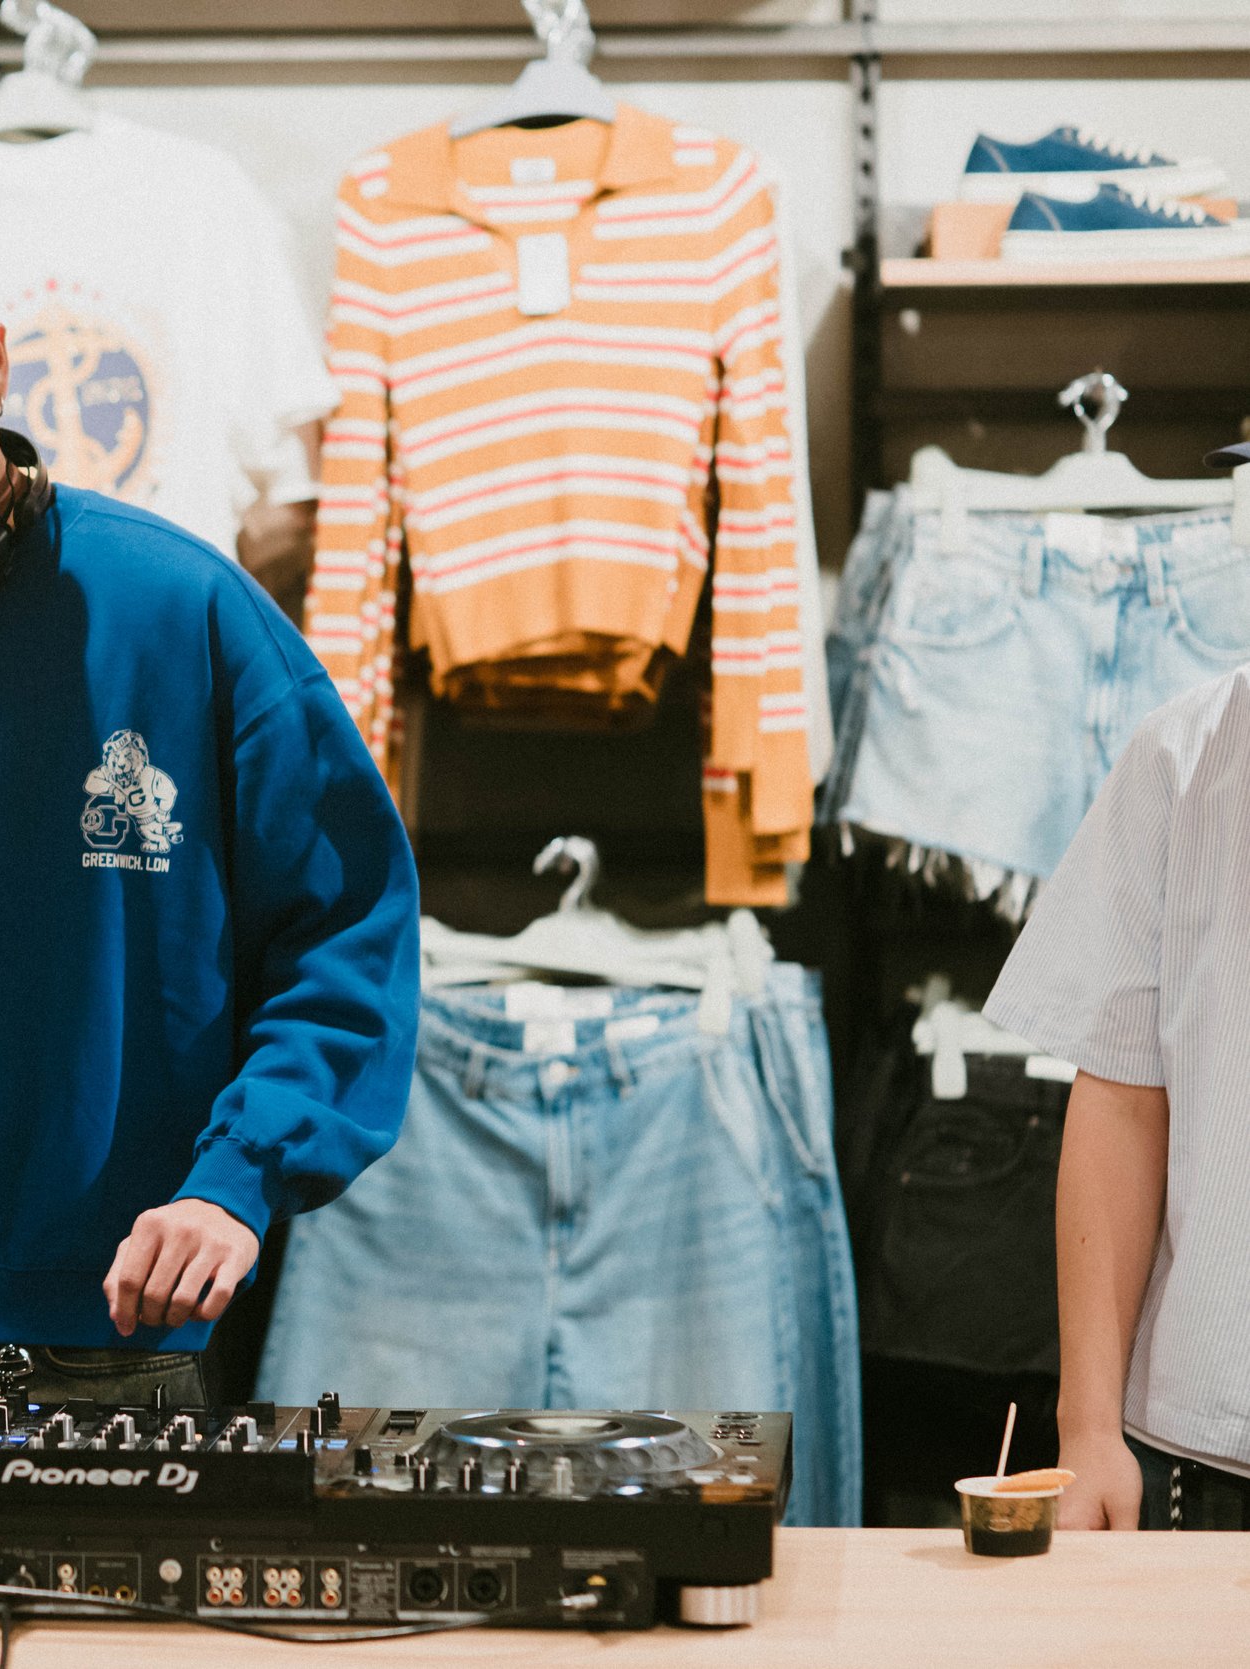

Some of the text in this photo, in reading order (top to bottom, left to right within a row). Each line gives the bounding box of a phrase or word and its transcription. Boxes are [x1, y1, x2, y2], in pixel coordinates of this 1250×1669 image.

[129, 788, 146, 807] G
[146, 857, 169, 872] LDN
[1, 1459, 149, 1485] Pioneer
